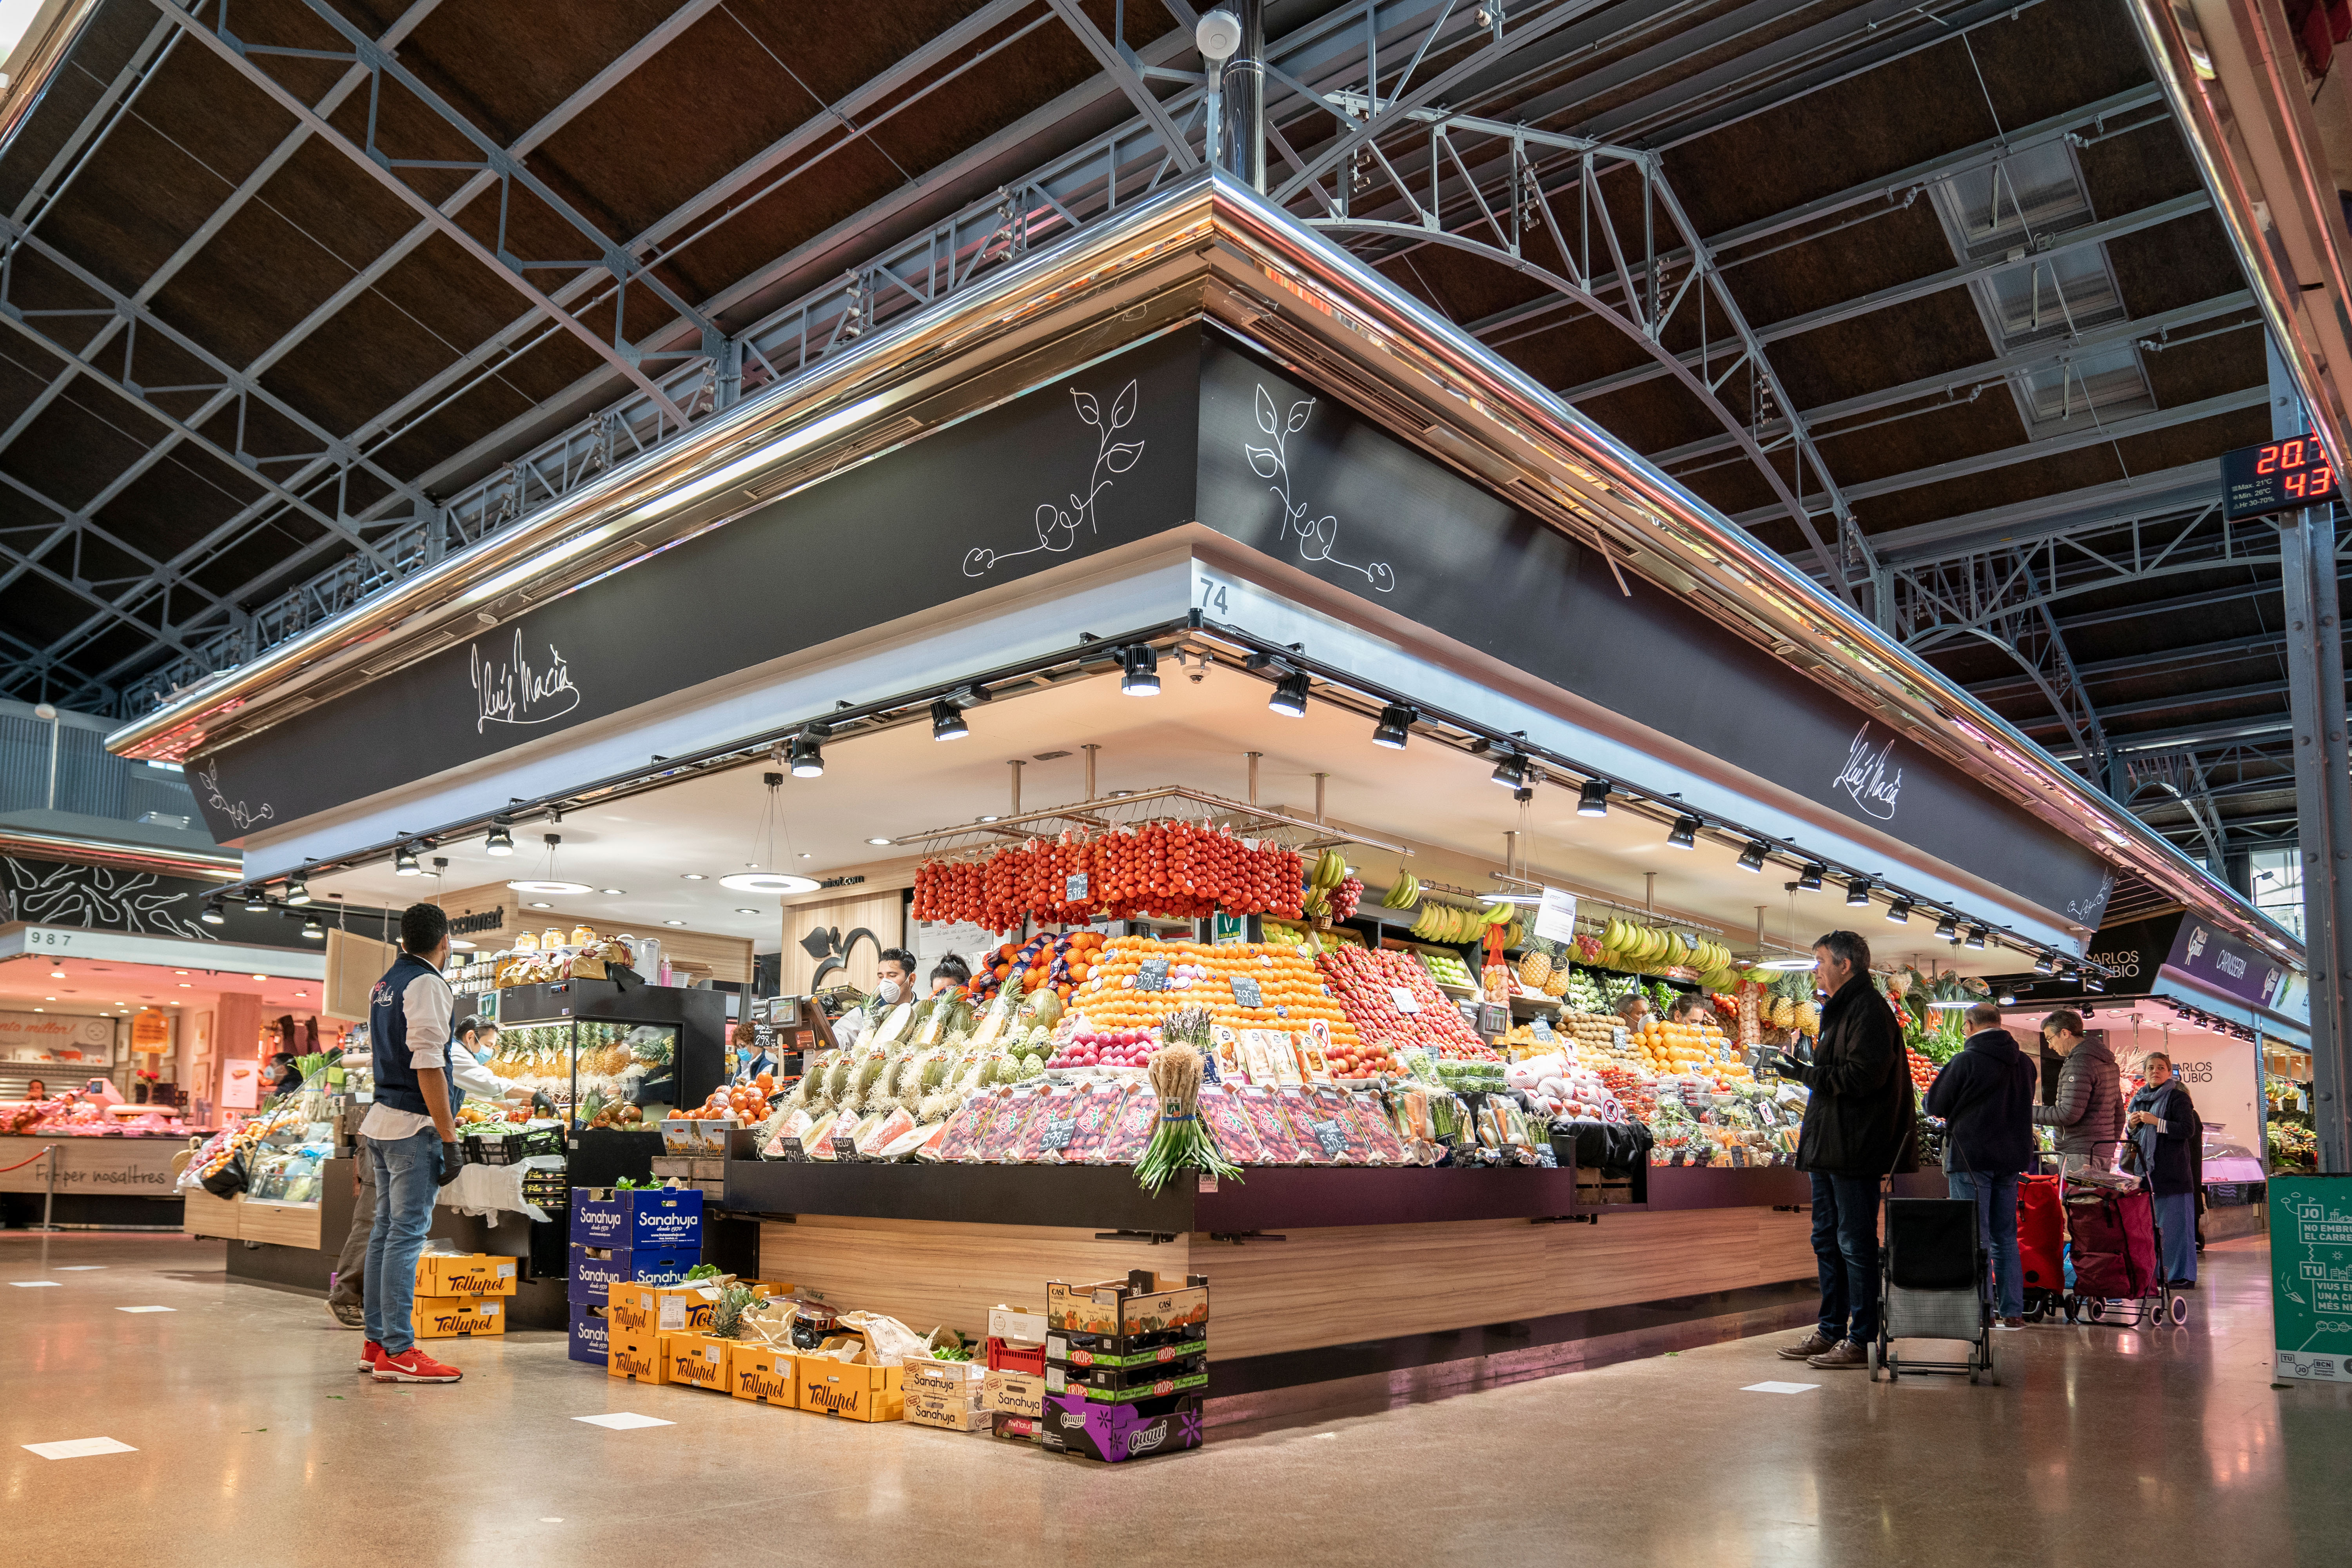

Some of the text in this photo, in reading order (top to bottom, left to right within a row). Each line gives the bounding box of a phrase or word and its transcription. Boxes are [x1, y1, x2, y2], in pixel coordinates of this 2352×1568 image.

[2285, 467, 2330, 497] 43
[2249, 496, 2274, 506] 30-70%
[1200, 577, 1228, 615] 74
[2073, 941, 2078, 953] 75
[2086, 951, 2139, 964] ARLOS
[2217, 949, 2247, 980] CARNISSERIA
[1136, 971, 1156, 989] 3,98
[1235, 989, 1256, 1006] 3,98
[2178, 1062, 2212, 1072] ARLOS
[2180, 1072, 2212, 1083] UBIO
[1040, 1131, 1063, 1147] 5,98
[1319, 1133, 1342, 1151] 5,98
[63, 1171, 87, 1187] per
[93, 1164, 166, 1185] nosaltres
[528, 1171, 543, 1179] Fres
[527, 1184, 543, 1193] Fres
[580, 1207, 621, 1229] Sanahuja
[639, 1212, 698, 1229] Sanahuja
[2301, 1209, 2319, 1218] JO
[2319, 1233, 2352, 1241] CARRE
[579, 1265, 620, 1283] Sanahuja
[2303, 1265, 2323, 1277] TU
[448, 1275, 505, 1292] Tollupol
[2317, 1282, 2340, 1291] VIUS
[1158, 1299, 1171, 1309] CASI
[2318, 1292, 2339, 1301] UNA
[2318, 1300, 2339, 1310] MÉS
[613, 1304, 646, 1328] Tollupol
[434, 1315, 493, 1334] Tollupol
[1071, 1351, 1093, 1363] TROPS
[1157, 1347, 1176, 1360] TROPS
[614, 1350, 651, 1376] Tollupol
[739, 1370, 785, 1399] Tollupol
[914, 1373, 953, 1392] Sanahuja
[1067, 1384, 1088, 1396] TROPS
[1154, 1381, 1174, 1394] TROPS
[808, 1382, 858, 1412] Tollupol
[998, 1392, 1040, 1411] Sanahuja
[916, 1405, 955, 1425] Sanahuja
[1061, 1412, 1086, 1428] Cuqui
[1128, 1419, 1167, 1455] Cuqui
